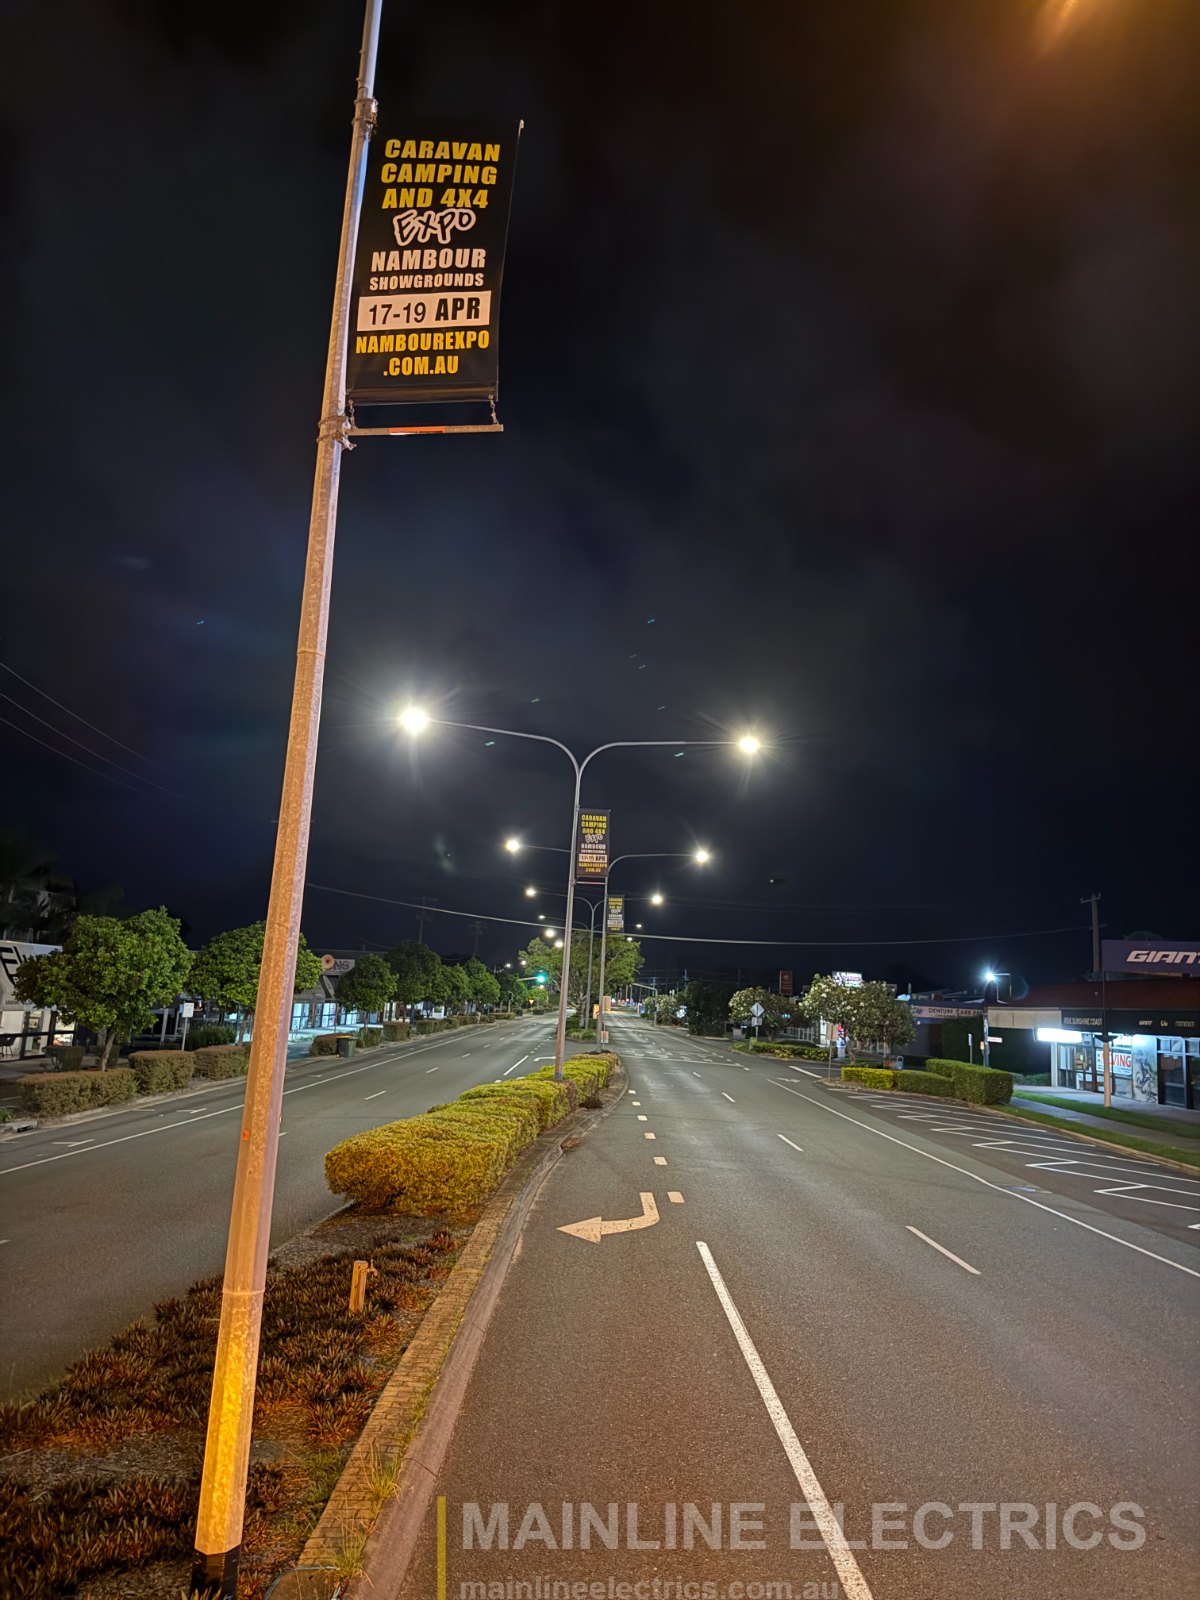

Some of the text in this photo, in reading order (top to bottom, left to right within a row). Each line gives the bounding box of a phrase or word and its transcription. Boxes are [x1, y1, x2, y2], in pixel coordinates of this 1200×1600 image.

[384, 138, 501, 162] CARAVAN
[381, 163, 498, 185] CAMPING
[381, 188, 489, 209] AND 4X4
[370, 248, 487, 272] NAMBOUR
[369, 272, 485, 292] SHOWGROUNDS
[368, 297, 481, 325] 17-19 APR
[355, 329, 490, 354] NAMBOUREXPO
[383, 355, 459, 377] .COM.AU
[1126, 950, 1200, 964] GIAN
